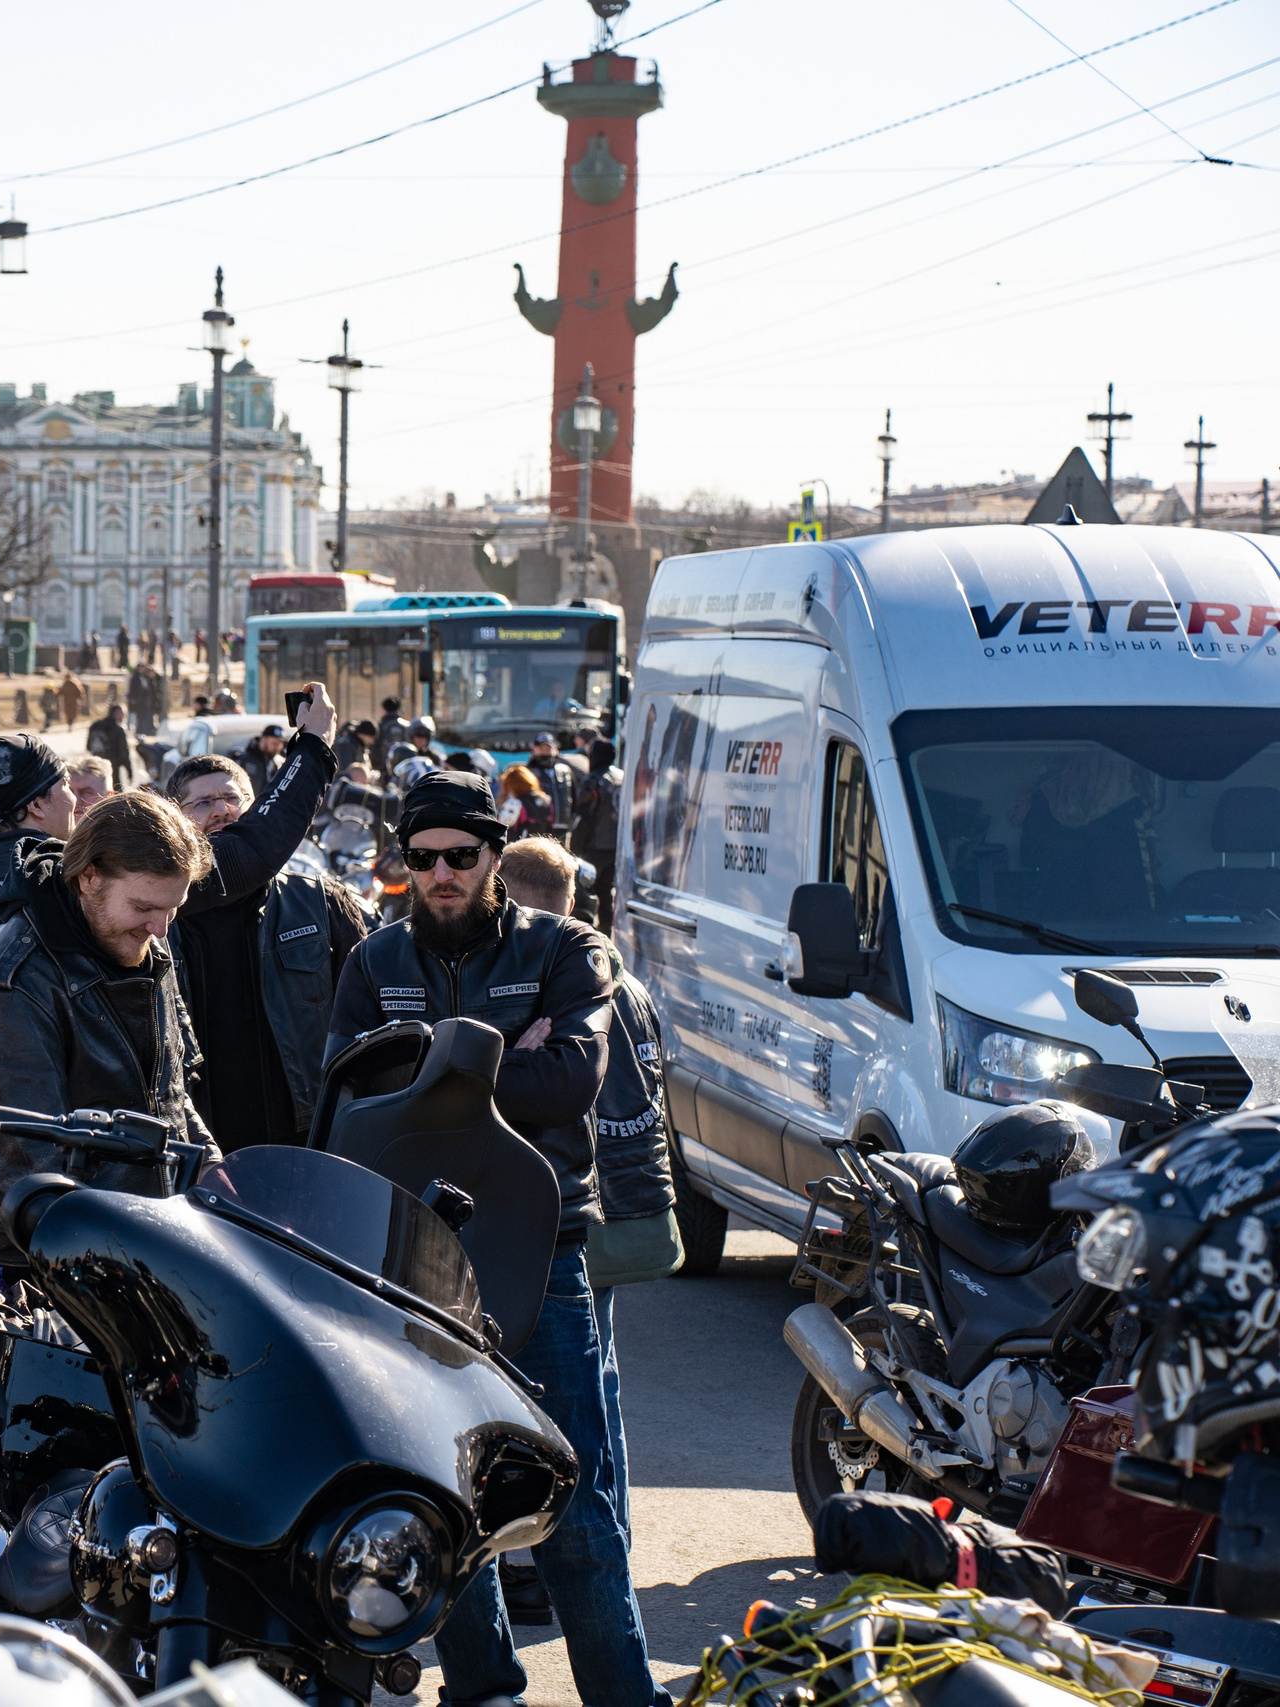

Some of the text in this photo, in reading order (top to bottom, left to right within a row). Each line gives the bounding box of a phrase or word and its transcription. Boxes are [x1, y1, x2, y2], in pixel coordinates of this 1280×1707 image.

[983, 638, 1162, 658] ОФИЦИАЛЬНЫЙ
[1177, 641, 1250, 654] ДИЛЕР
[725, 740, 783, 775] VETERR
[258, 754, 302, 815] SWEEP
[725, 804, 771, 834] VETERR.COM
[724, 842, 767, 875] BRP.SPB.RU
[281, 926, 317, 942] MEMBER
[381, 989, 425, 997] HOOLIGANS
[492, 984, 538, 995] VICE PRES
